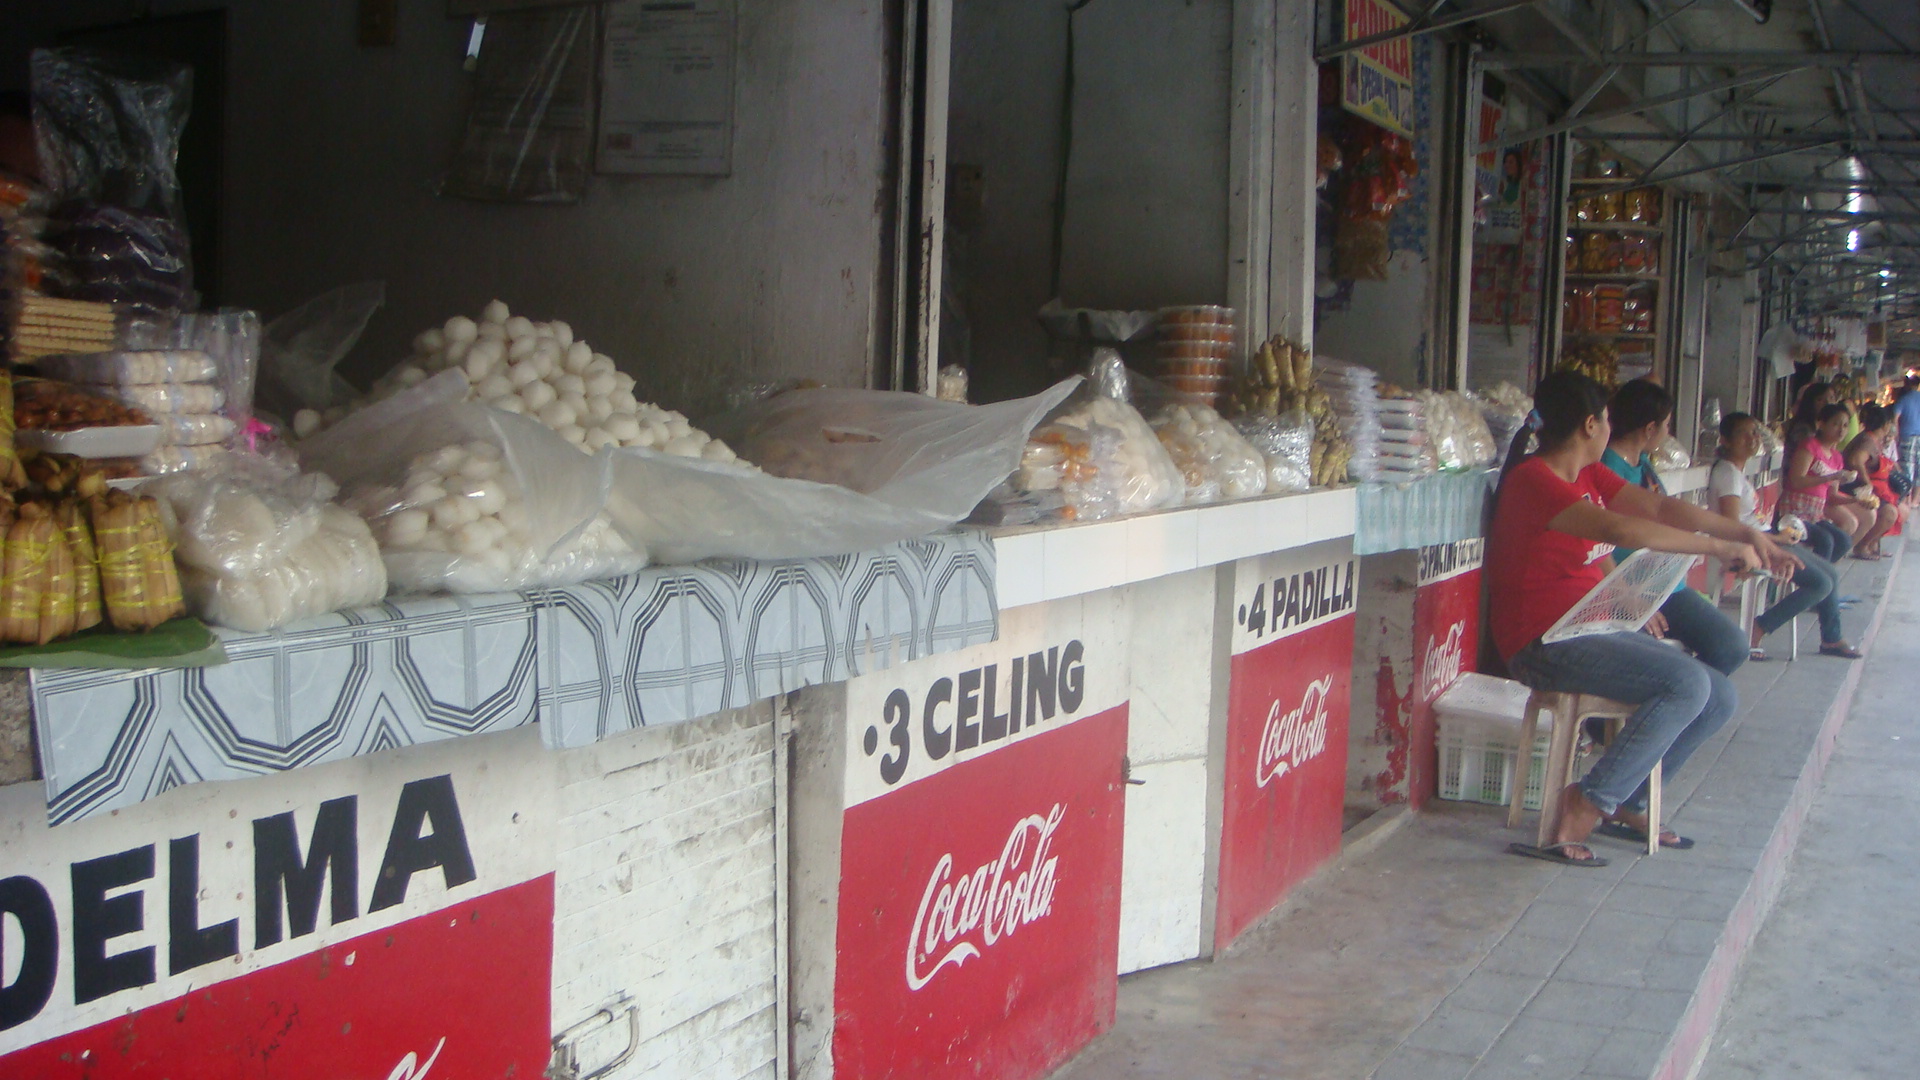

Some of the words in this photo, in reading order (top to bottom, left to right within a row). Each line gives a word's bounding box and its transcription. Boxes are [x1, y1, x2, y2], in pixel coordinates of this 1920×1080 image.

[1271, 561, 1354, 633] PADILLA
[923, 639, 1085, 761] CELING
[1256, 673, 1334, 788] Coca-Cola
[0, 773, 477, 1031] DELMA
[905, 803, 1068, 991] Coca-Cola
